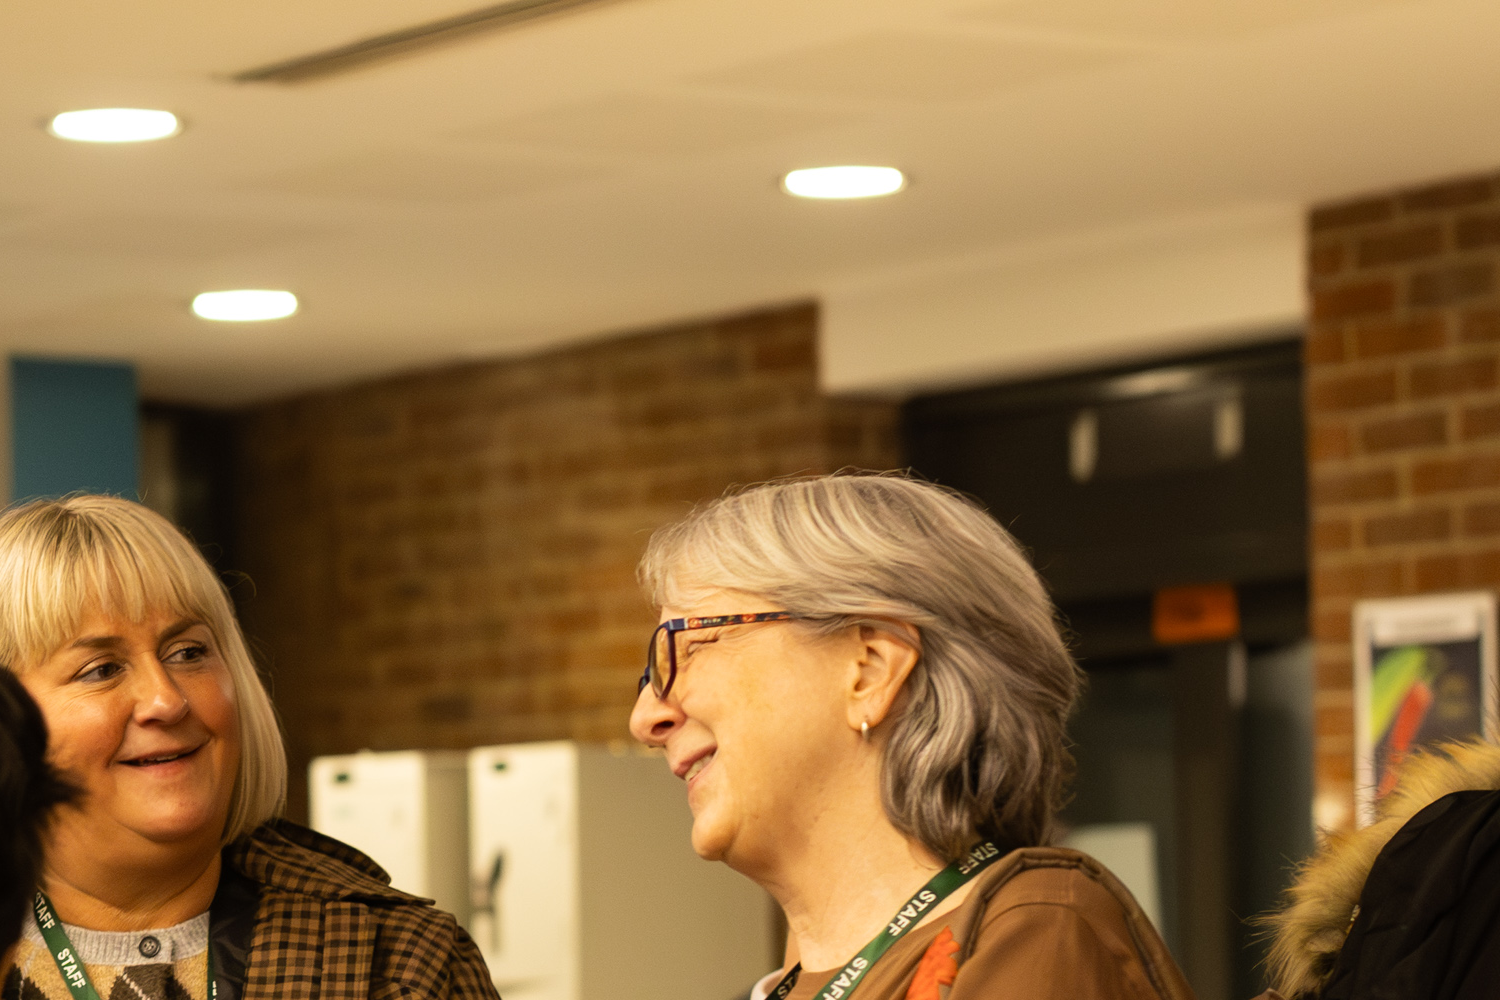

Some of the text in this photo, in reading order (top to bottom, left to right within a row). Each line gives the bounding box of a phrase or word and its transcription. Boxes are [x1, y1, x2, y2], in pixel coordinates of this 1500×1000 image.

[958, 841, 999, 875] STAFF
[888, 889, 937, 937] STAFF
[57, 947, 87, 989] STAFF
